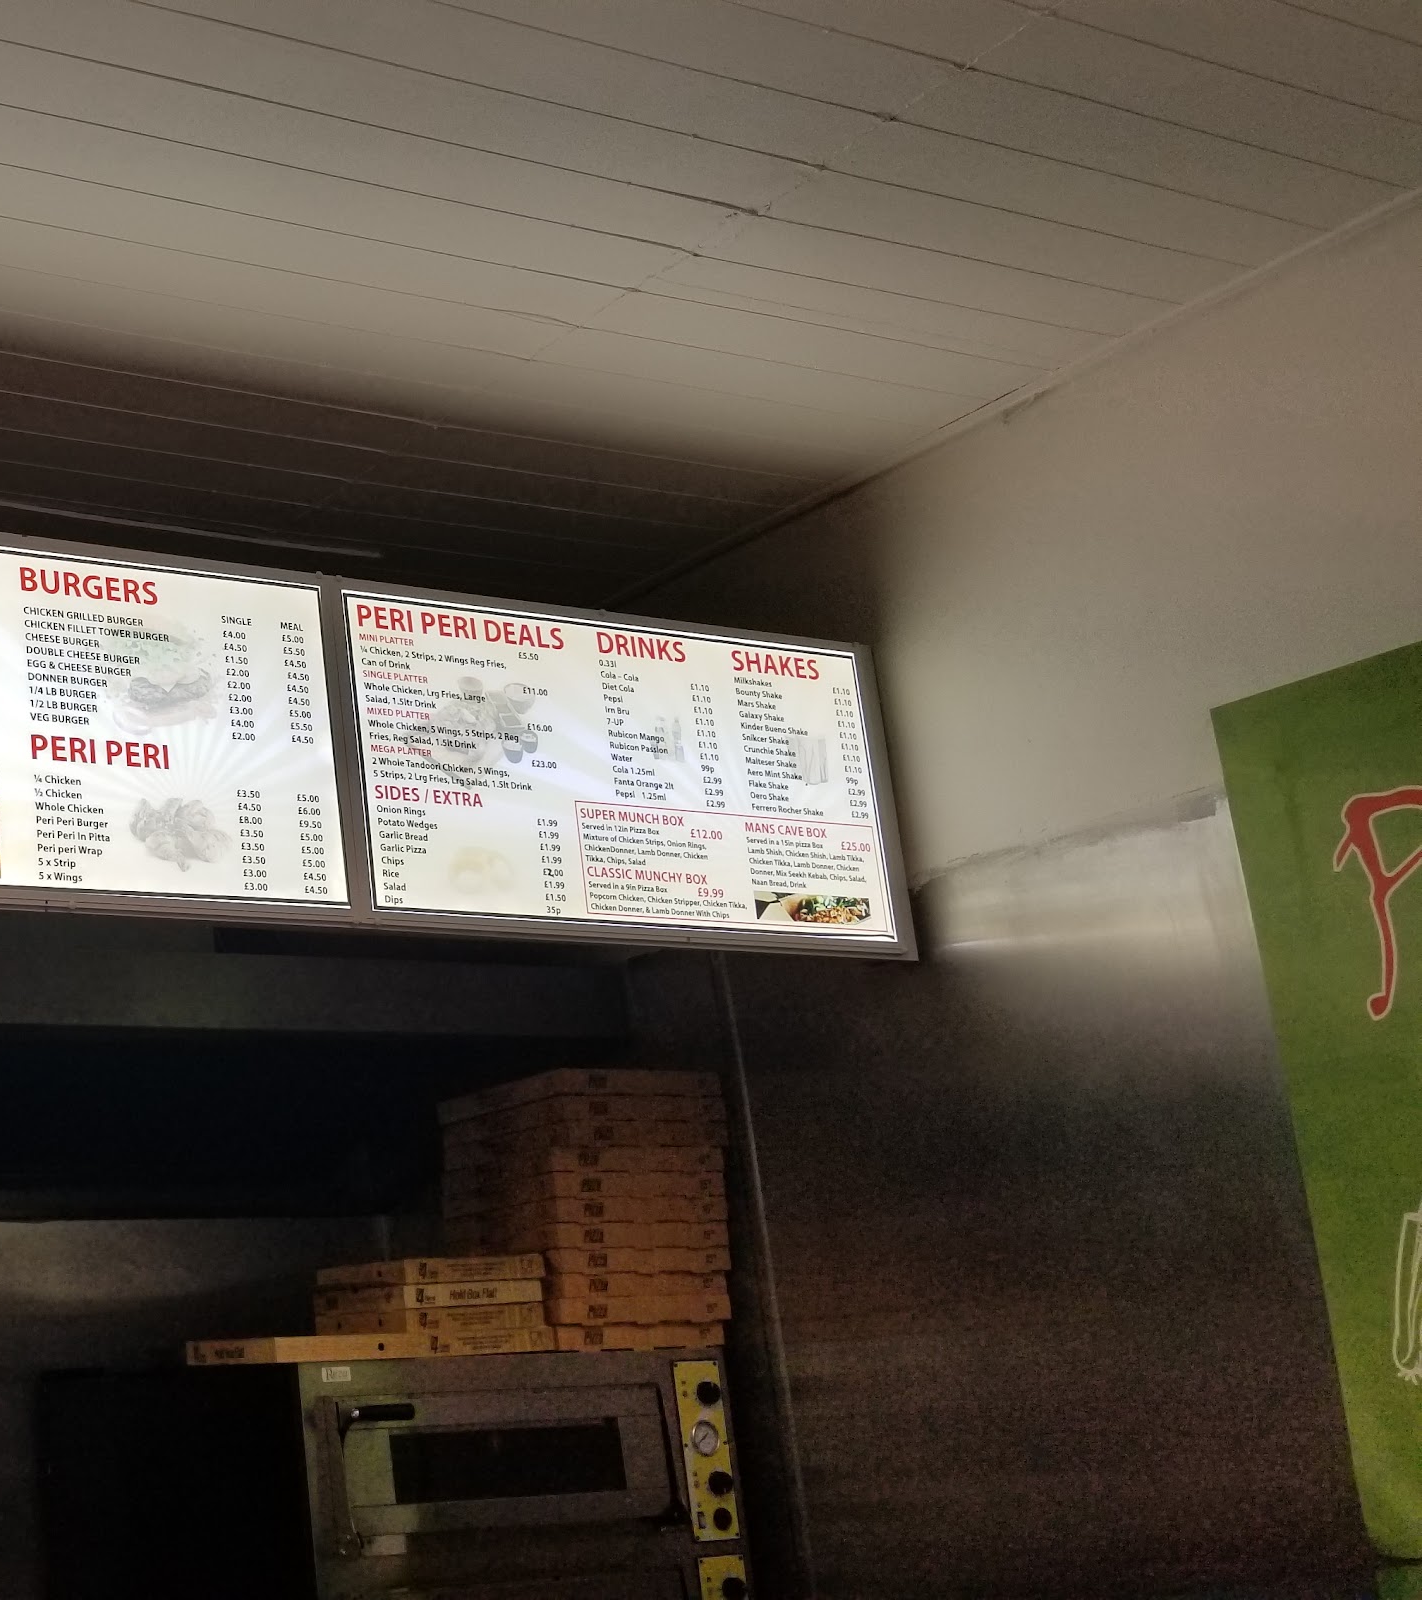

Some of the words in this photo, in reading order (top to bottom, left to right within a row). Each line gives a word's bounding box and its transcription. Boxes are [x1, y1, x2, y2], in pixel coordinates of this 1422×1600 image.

[19, 566, 157, 605] BURGERS
[220, 615, 252, 626] SINGLE
[279, 621, 303, 631] MEAL
[356, 603, 413, 633] PERI
[420, 611, 477, 640] PERI
[483, 619, 564, 649] DEALS
[24, 632, 60, 643] CHEESE
[62, 636, 99, 648] BURGER
[225, 655, 248, 665] £1.50
[284, 659, 306, 668] £4.50
[358, 632, 377, 642] MINI
[379, 635, 414, 646] PLATTER
[518, 651, 538, 660] £5.50
[595, 630, 686, 662] DRINKS
[730, 649, 819, 680] SHAKES
[601, 681, 617, 691] Diet
[618, 683, 634, 692] Cola
[691, 694, 711, 703] £1.10
[740, 721, 763, 731] Kinder
[764, 724, 786, 733] Bueno
[787, 726, 808, 736] Shake
[839, 731, 857, 740] £1.10
[30, 733, 96, 764] PERI
[105, 740, 169, 769] PERI
[370, 743, 395, 753] MEGA
[396, 745, 432, 757] PLATTER
[374, 784, 420, 802] SIDES
[424, 788, 428, 803] /
[432, 789, 483, 807] EXTRA
[34, 801, 65, 811] Whole
[67, 803, 103, 814] Chicken
[238, 815, 262, 825] £8.00
[298, 819, 322, 828] £9.50
[579, 807, 616, 821] SUPER
[618, 810, 659, 824] MUNCH
[661, 814, 684, 826] BOX
[690, 828, 722, 840] £12.00
[744, 821, 775, 834] MANS
[777, 824, 804, 836] CAVE
[805, 826, 827, 838] BOX
[378, 830, 403, 839] Garlic
[404, 831, 428, 841] Bread
[539, 842, 560, 852] £1.99
[840, 840, 870, 852] £25.00
[38, 871, 44, 879] 5
[53, 871, 82, 883] Wings
[244, 882, 268, 891] £3.00
[304, 885, 327, 894] £4.50
[586, 865, 632, 879] CLASSIC
[634, 869, 682, 883] MUNCHY
[685, 873, 707, 885] BOX
[697, 887, 723, 898] £9.99
[384, 894, 403, 905] Dips
[546, 905, 561, 915] 35p
